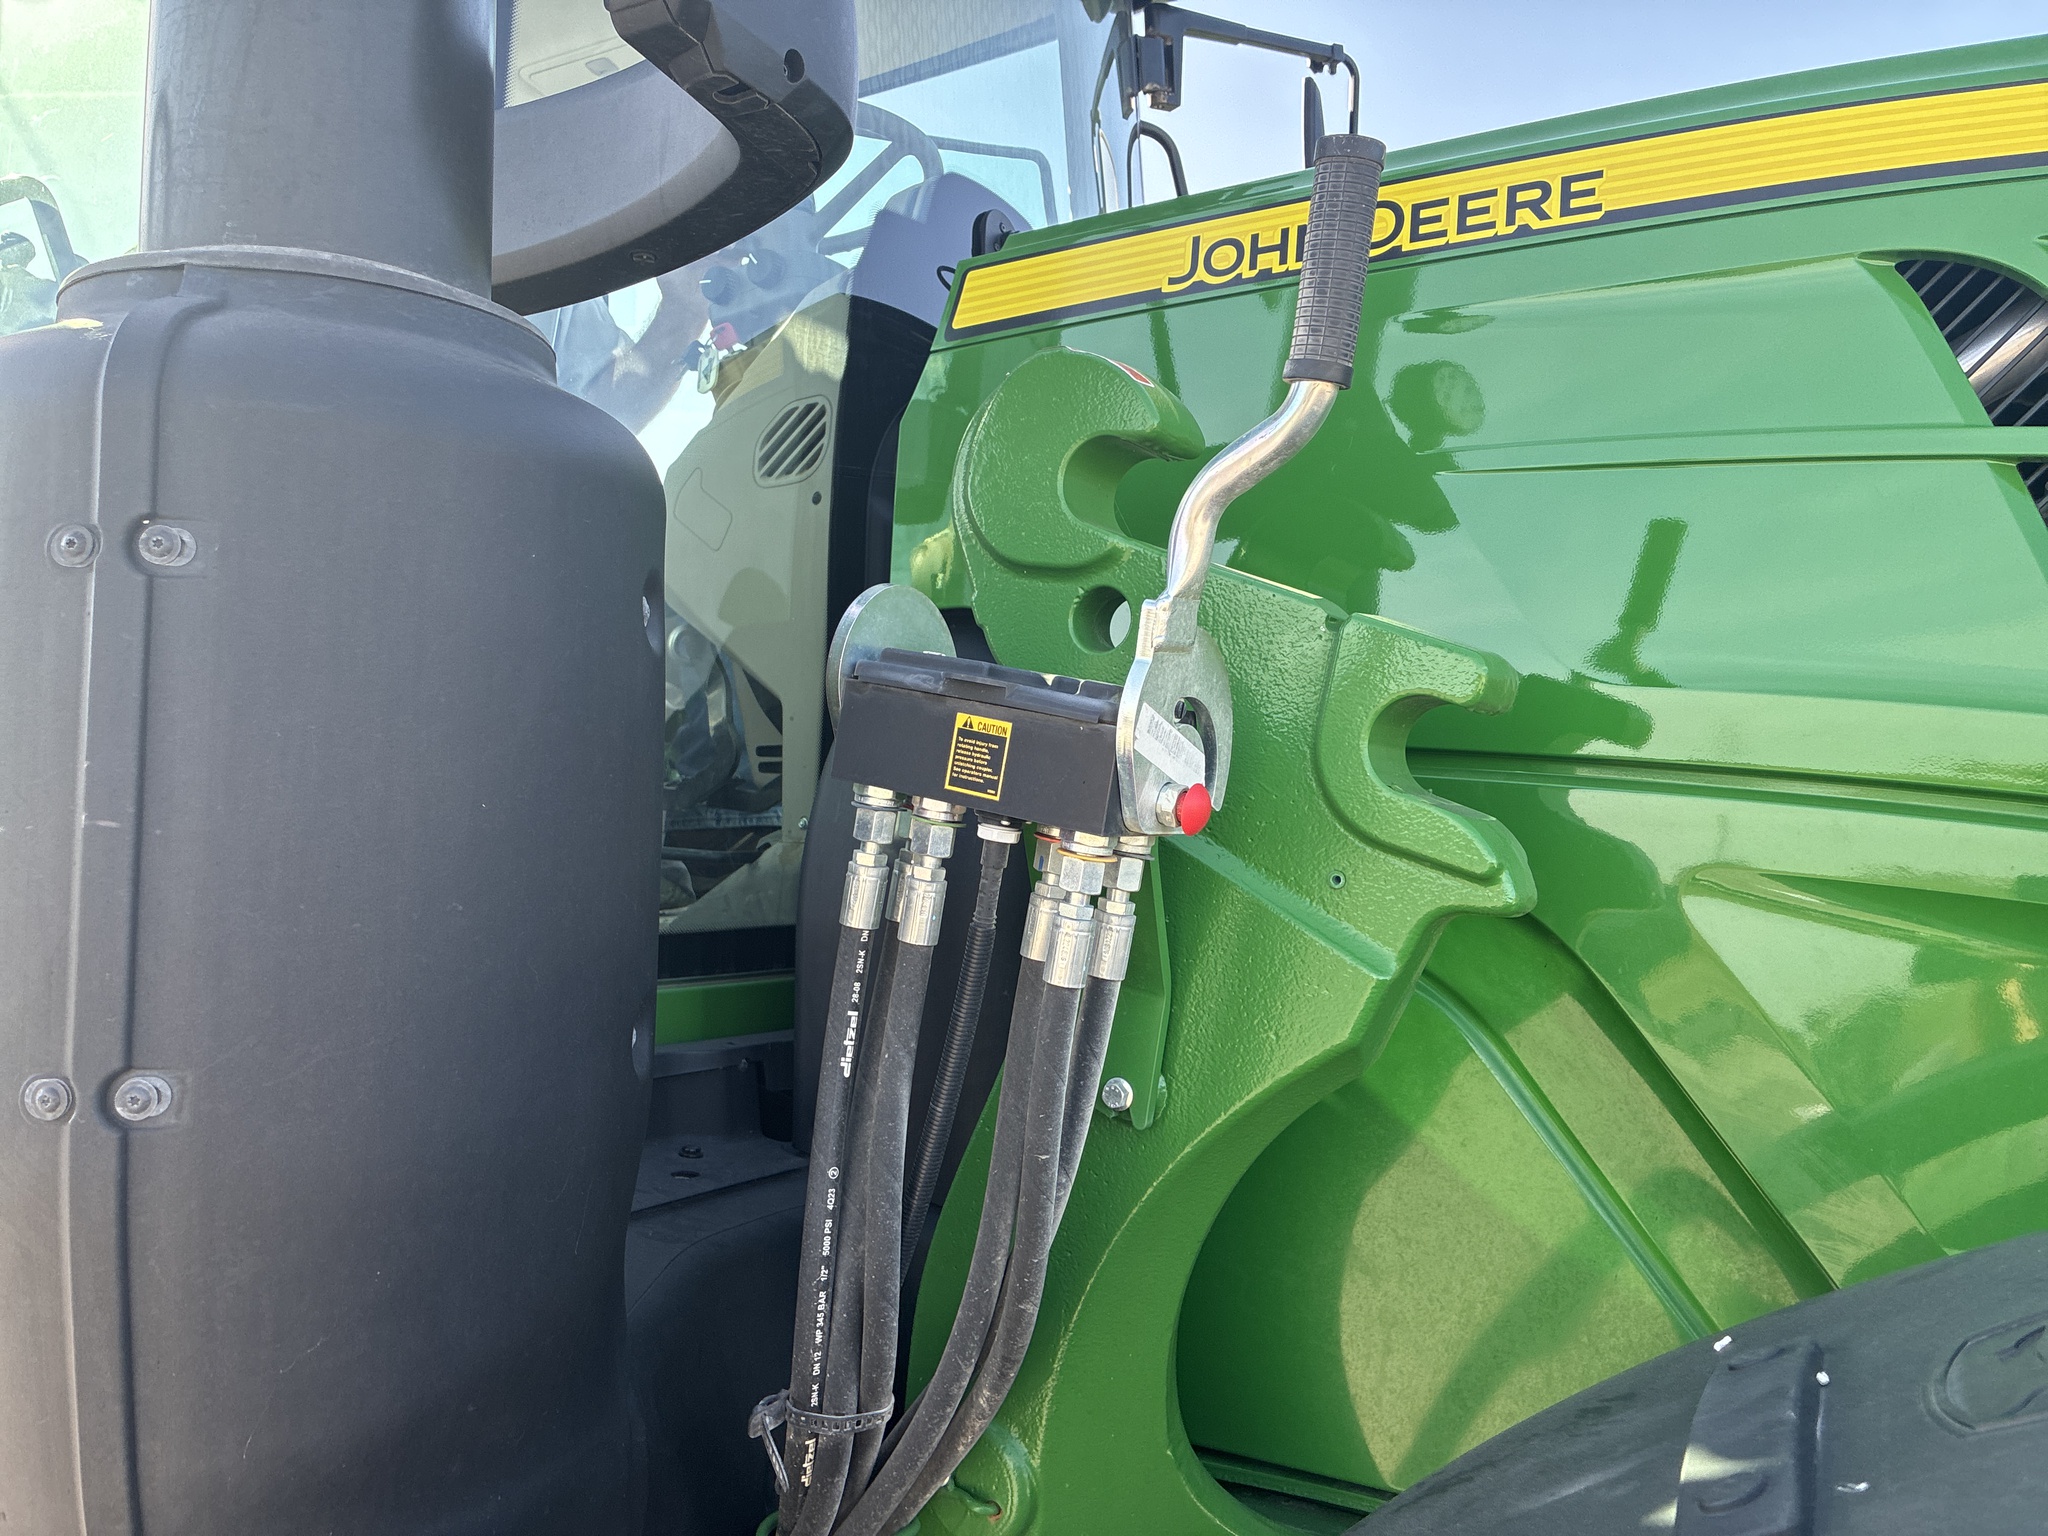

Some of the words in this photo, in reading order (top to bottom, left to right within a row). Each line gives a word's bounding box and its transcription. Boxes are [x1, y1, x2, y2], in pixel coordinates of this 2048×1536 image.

[977, 722, 1007, 736] CAUTION
[957, 743, 973, 751] rotating
[972, 752, 991, 760] hydraulic
[860, 930, 870, 942] DN
[856, 950, 866, 974] 2SN-K
[851, 981, 861, 1003] 28-08
[840, 1011, 859, 1078] dietzel
[827, 1188, 836, 1211] 4Q23
[823, 1219, 833, 1234] PSI
[822, 1235, 831, 1256] 5000
[820, 1266, 829, 1282] 1/2"
[818, 1291, 826, 1312] BAR
[817, 1312, 825, 1329] 345
[815, 1329, 823, 1344] WP
[814, 1351, 822, 1362] 12
[813, 1363, 820, 1375] DN
[811, 1383, 820, 1407] 2SN-K
[801, 1438, 816, 1487] dietzel
